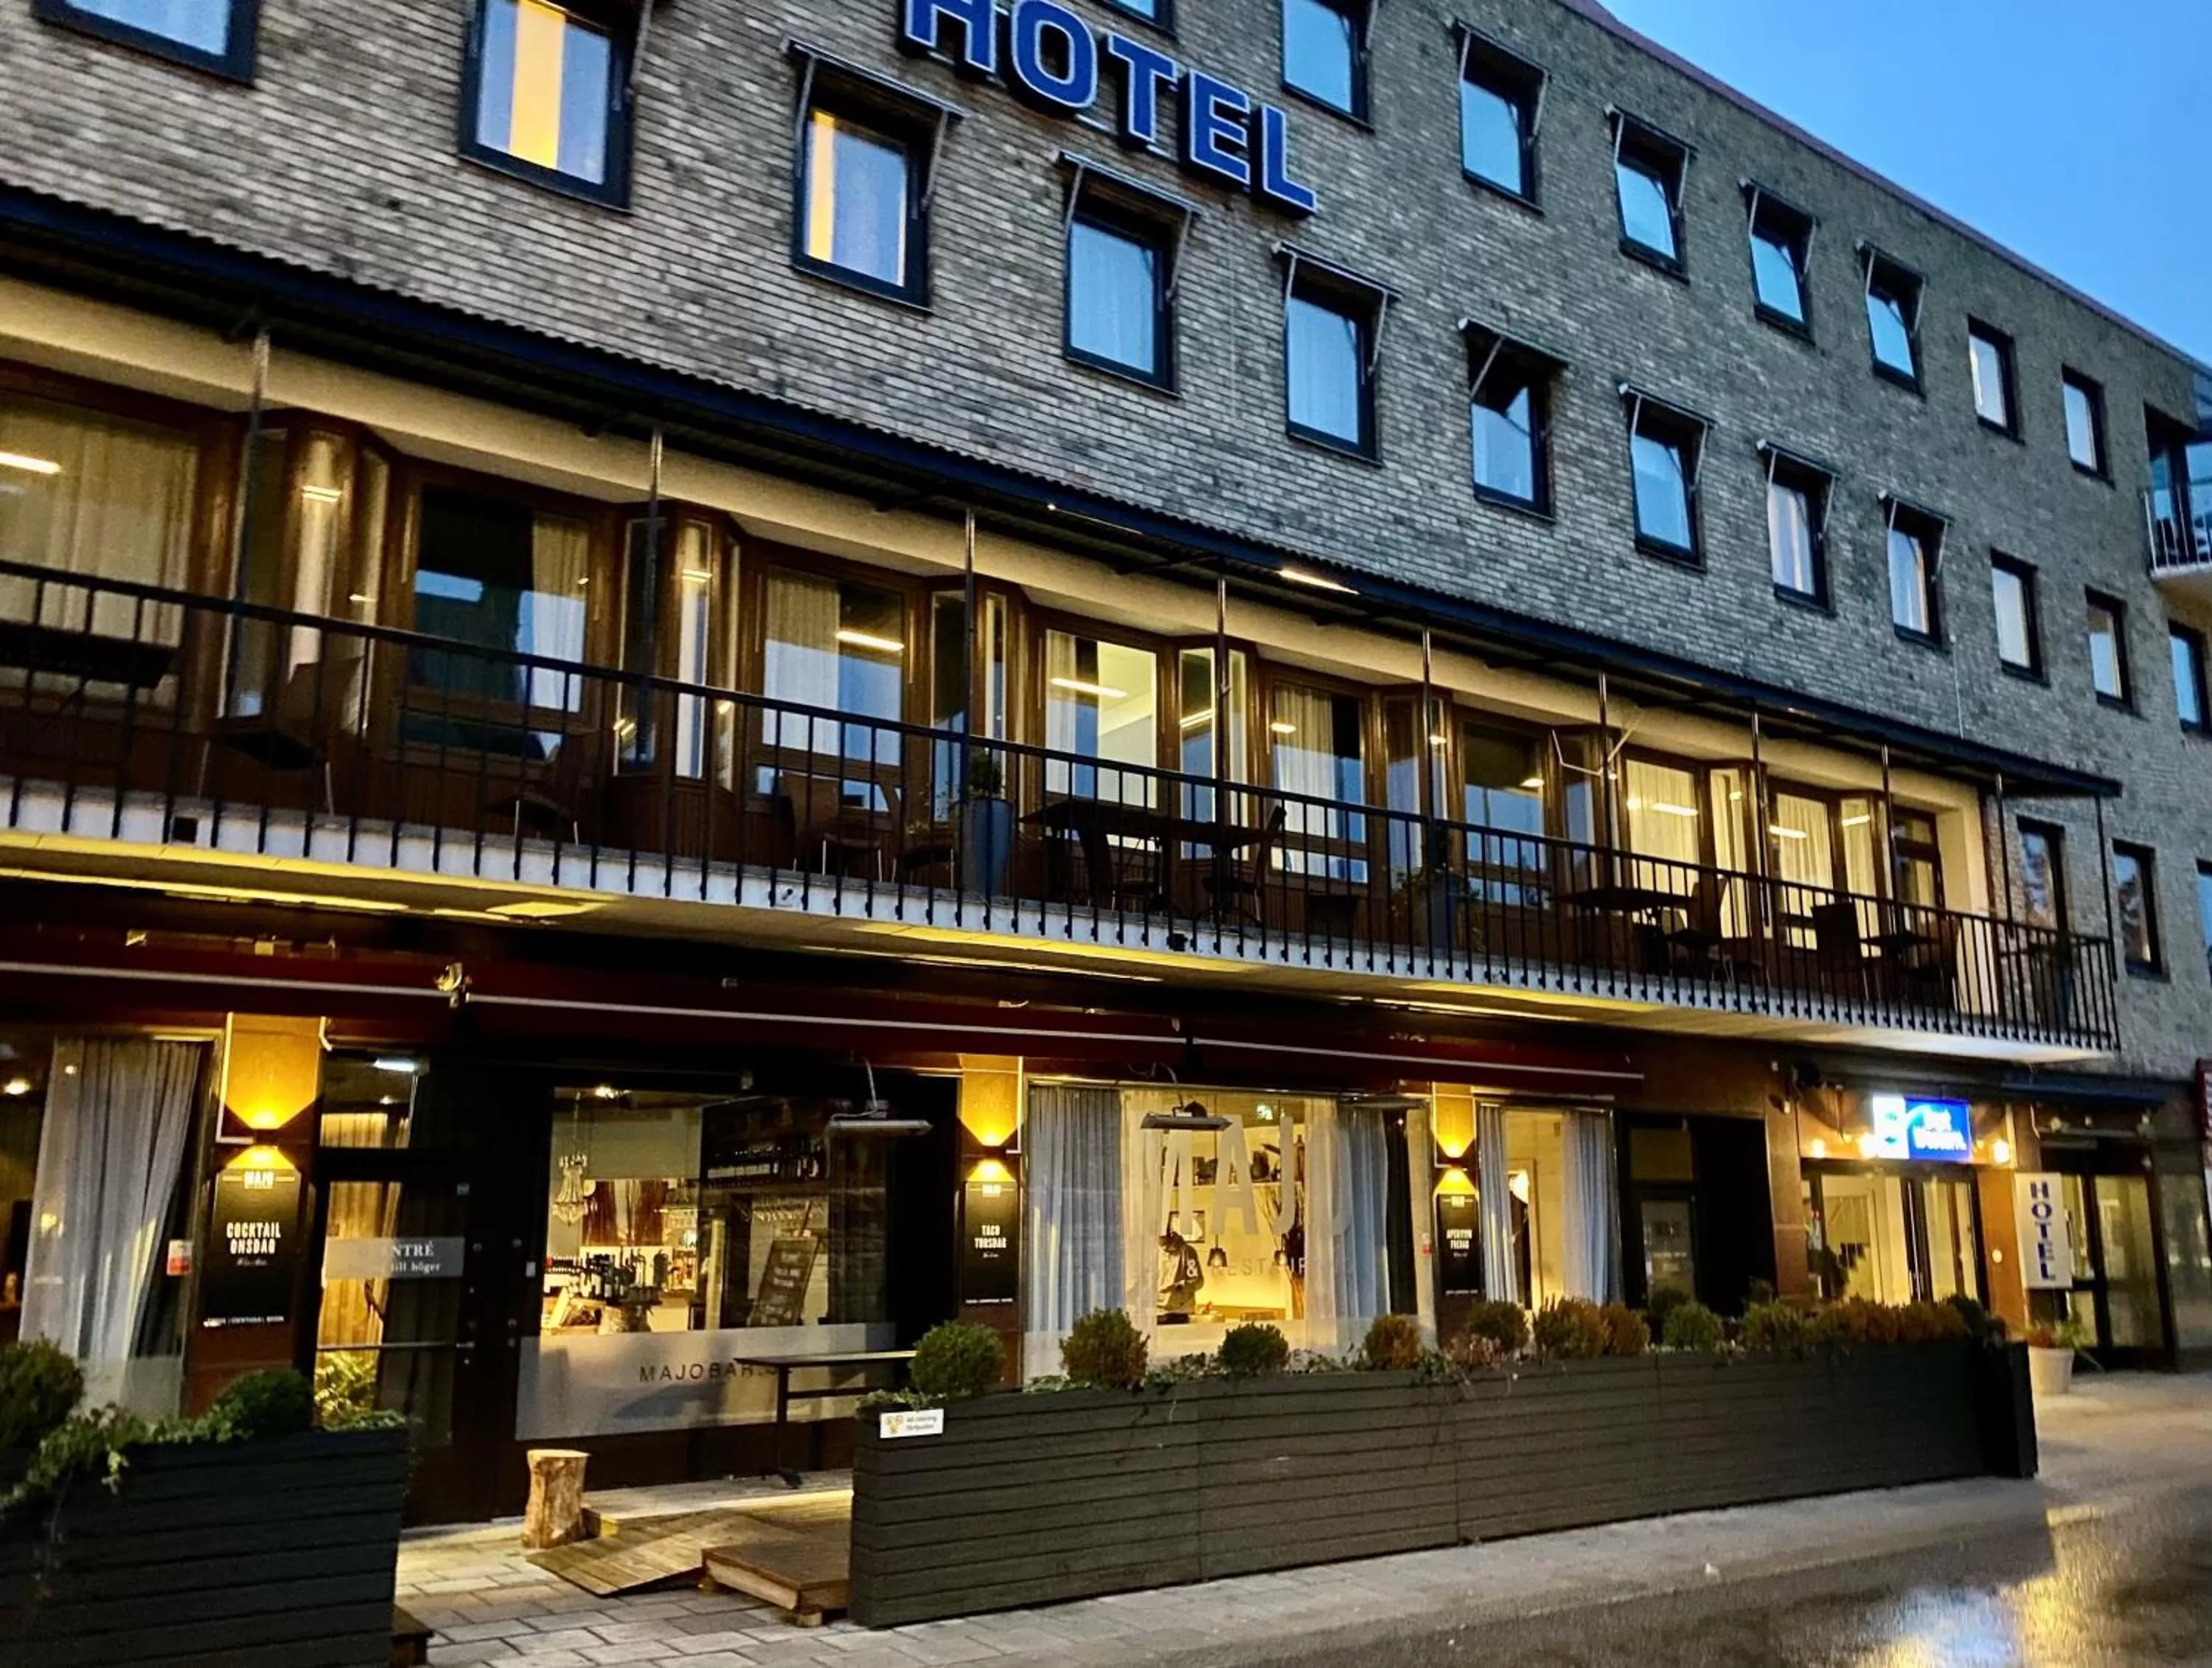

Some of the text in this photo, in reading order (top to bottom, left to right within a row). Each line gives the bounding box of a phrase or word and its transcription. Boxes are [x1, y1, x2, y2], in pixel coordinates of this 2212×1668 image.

[904, 0, 1318, 214] HOTEL
[226, 1222, 282, 1238] COCKTAIL
[981, 1225, 1001, 1237] TACO
[2030, 1181, 2056, 1282] HOTEL
[230, 1238, 276, 1254] ONSDAG
[1186, 1259, 1199, 1278] &
